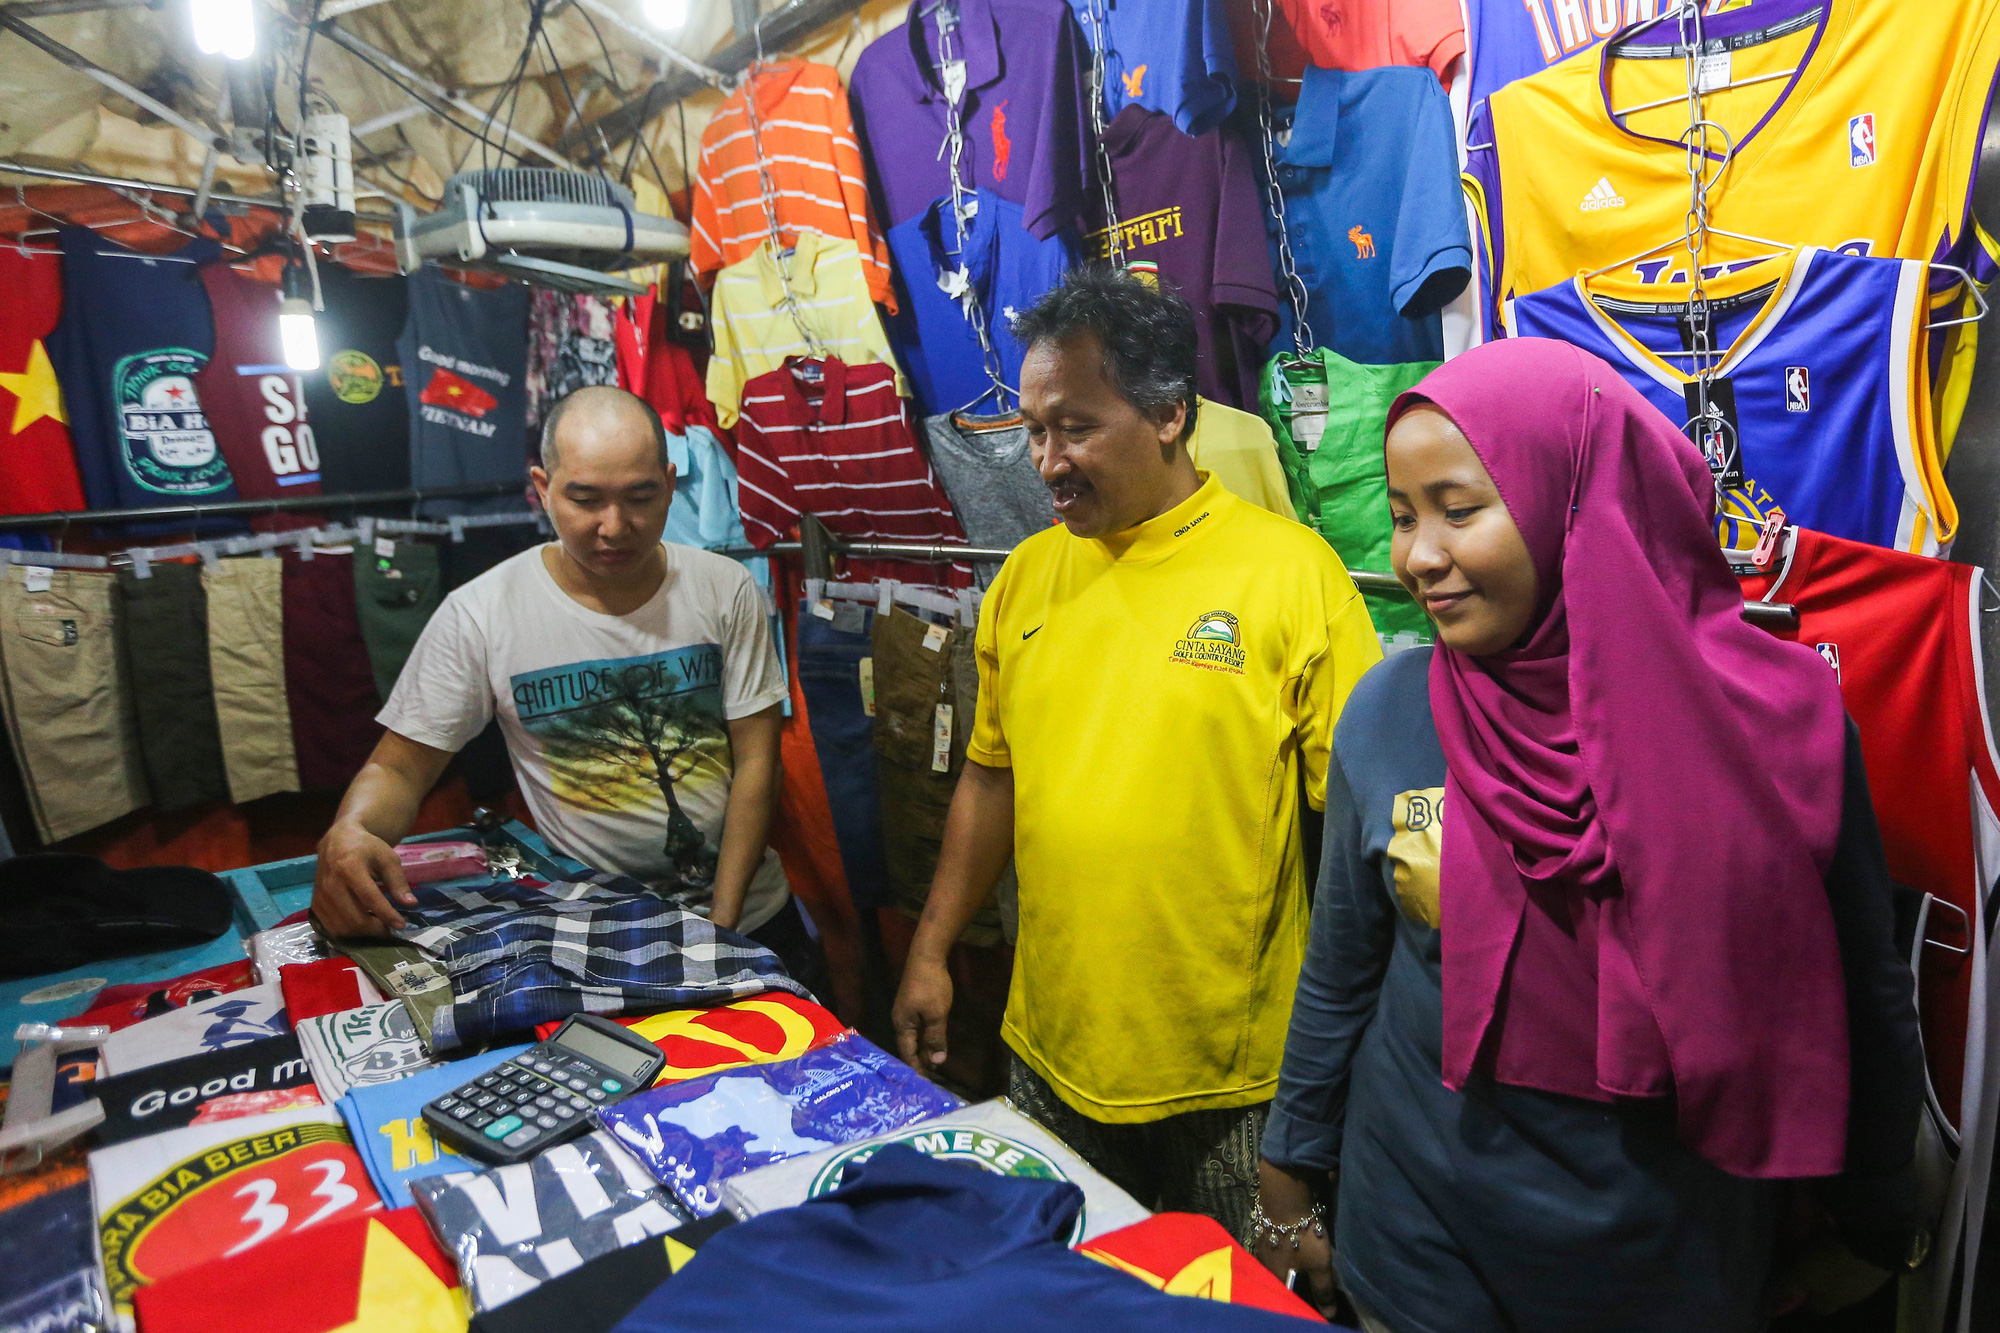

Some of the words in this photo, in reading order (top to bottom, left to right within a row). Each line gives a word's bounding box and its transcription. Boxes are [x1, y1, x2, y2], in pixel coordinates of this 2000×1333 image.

[1853, 155, 1868, 166] NBA
[1580, 196, 1625, 211] adidas
[1083, 206, 1184, 258] errari
[1790, 401, 1802, 411] NBA
[1174, 650, 1189, 659] GOLF
[1194, 652, 1224, 663] COUNTRY
[1224, 656, 1244, 668] RESORT
[1176, 640, 1205, 652] CINTA
[1209, 643, 1246, 660] SAYANG
[513, 667, 612, 714] NATURE
[624, 660, 668, 692] OF
[130, 1067, 257, 1118] Good
[140, 1167, 203, 1209] BIA
[204, 1130, 297, 1173] BEER
